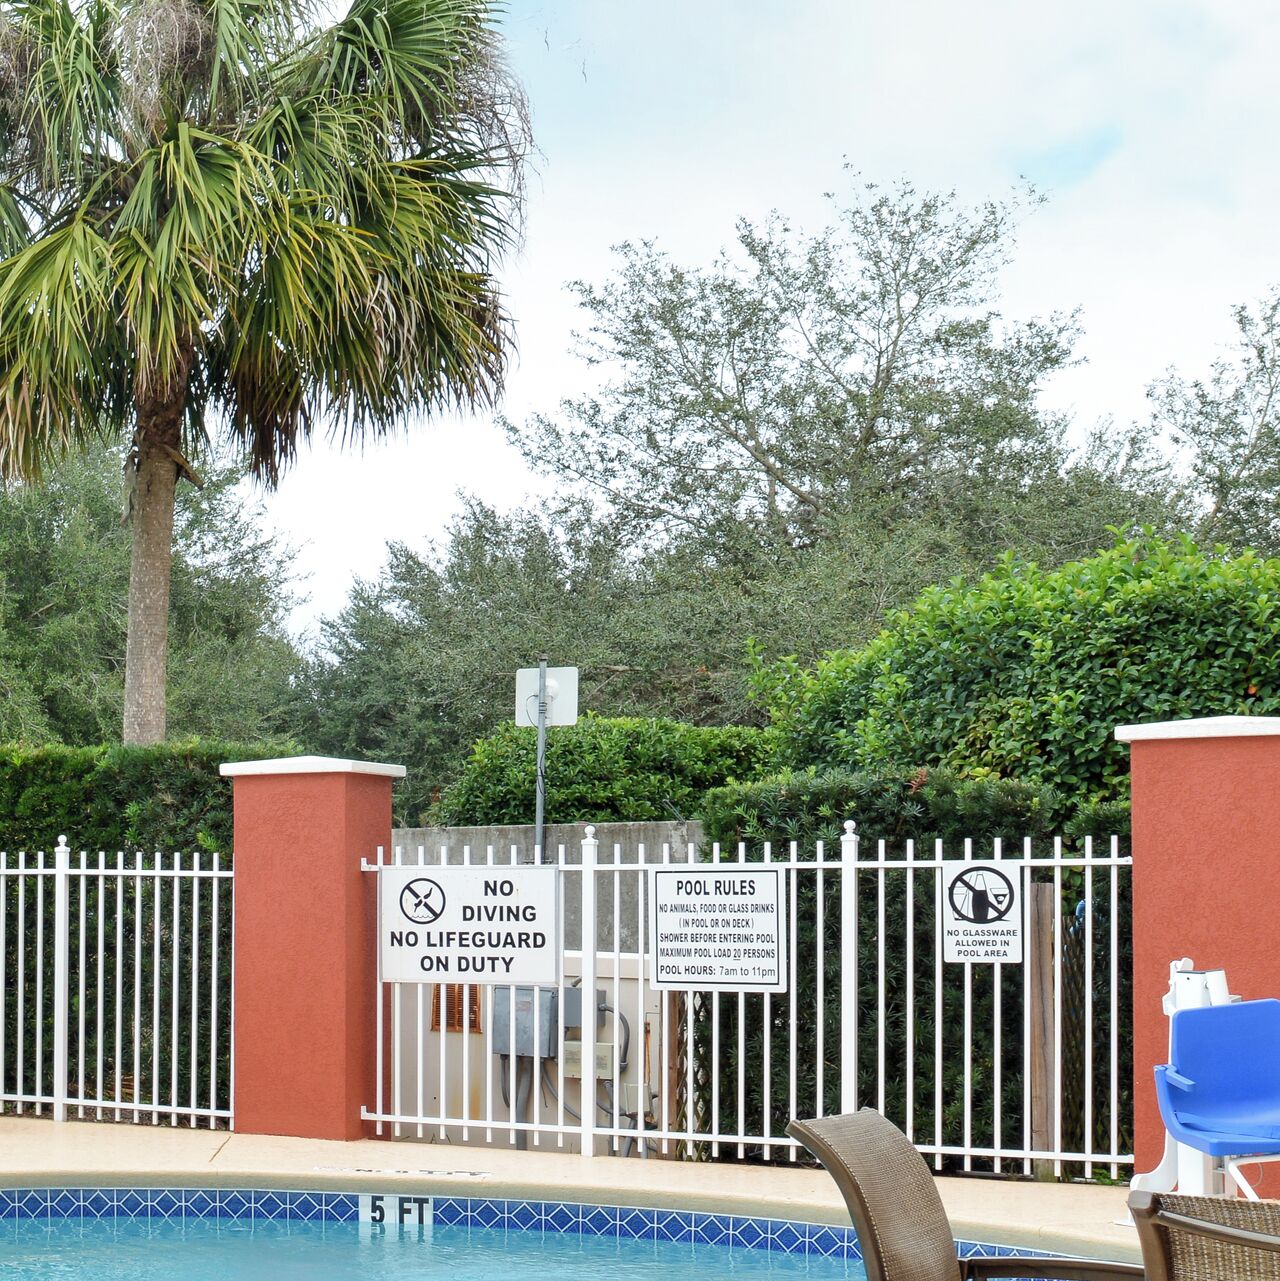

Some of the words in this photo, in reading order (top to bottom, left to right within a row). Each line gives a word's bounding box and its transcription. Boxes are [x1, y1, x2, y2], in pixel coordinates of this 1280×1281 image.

[484, 880, 514, 897] NO
[676, 880, 710, 895] POOL
[714, 880, 756, 895] RULES
[462, 905, 537, 922] DIVING
[659, 904, 668, 913] NO
[669, 904, 699, 914] ANIMALS,
[700, 904, 717, 913] FOOD
[718, 904, 727, 913] OR
[728, 904, 749, 913] GLASS
[751, 904, 775, 913] DRINKS
[691, 919, 709, 928] POOL
[710, 919, 720, 928] OR
[721, 919, 731, 928] ON
[390, 931, 419, 947] NO
[426, 931, 546, 949] LIFEGUARD
[659, 933, 689, 943] SHOWER
[690, 933, 717, 943] BEFORE
[719, 933, 755, 943] ENTERING
[756, 934, 775, 943] POOL
[946, 929, 960, 937] NO
[962, 929, 1018, 937] GLASSWARE
[660, 948, 692, 958] MAXIMUM
[694, 948, 712, 958] POOL
[713, 948, 732, 958] LOAD
[733, 949, 741, 959] 20
[743, 949, 776, 959] PERSONS
[420, 956, 449, 972] ON
[457, 956, 515, 973] DUTY
[660, 965, 682, 975] POOL
[684, 965, 716, 976] HOURS:
[719, 966, 738, 976] 7am
[740, 967, 749, 976] to
[751, 966, 776, 979] 11pm
[370, 1196, 385, 1223] 5
[398, 1197, 429, 1224] FT
